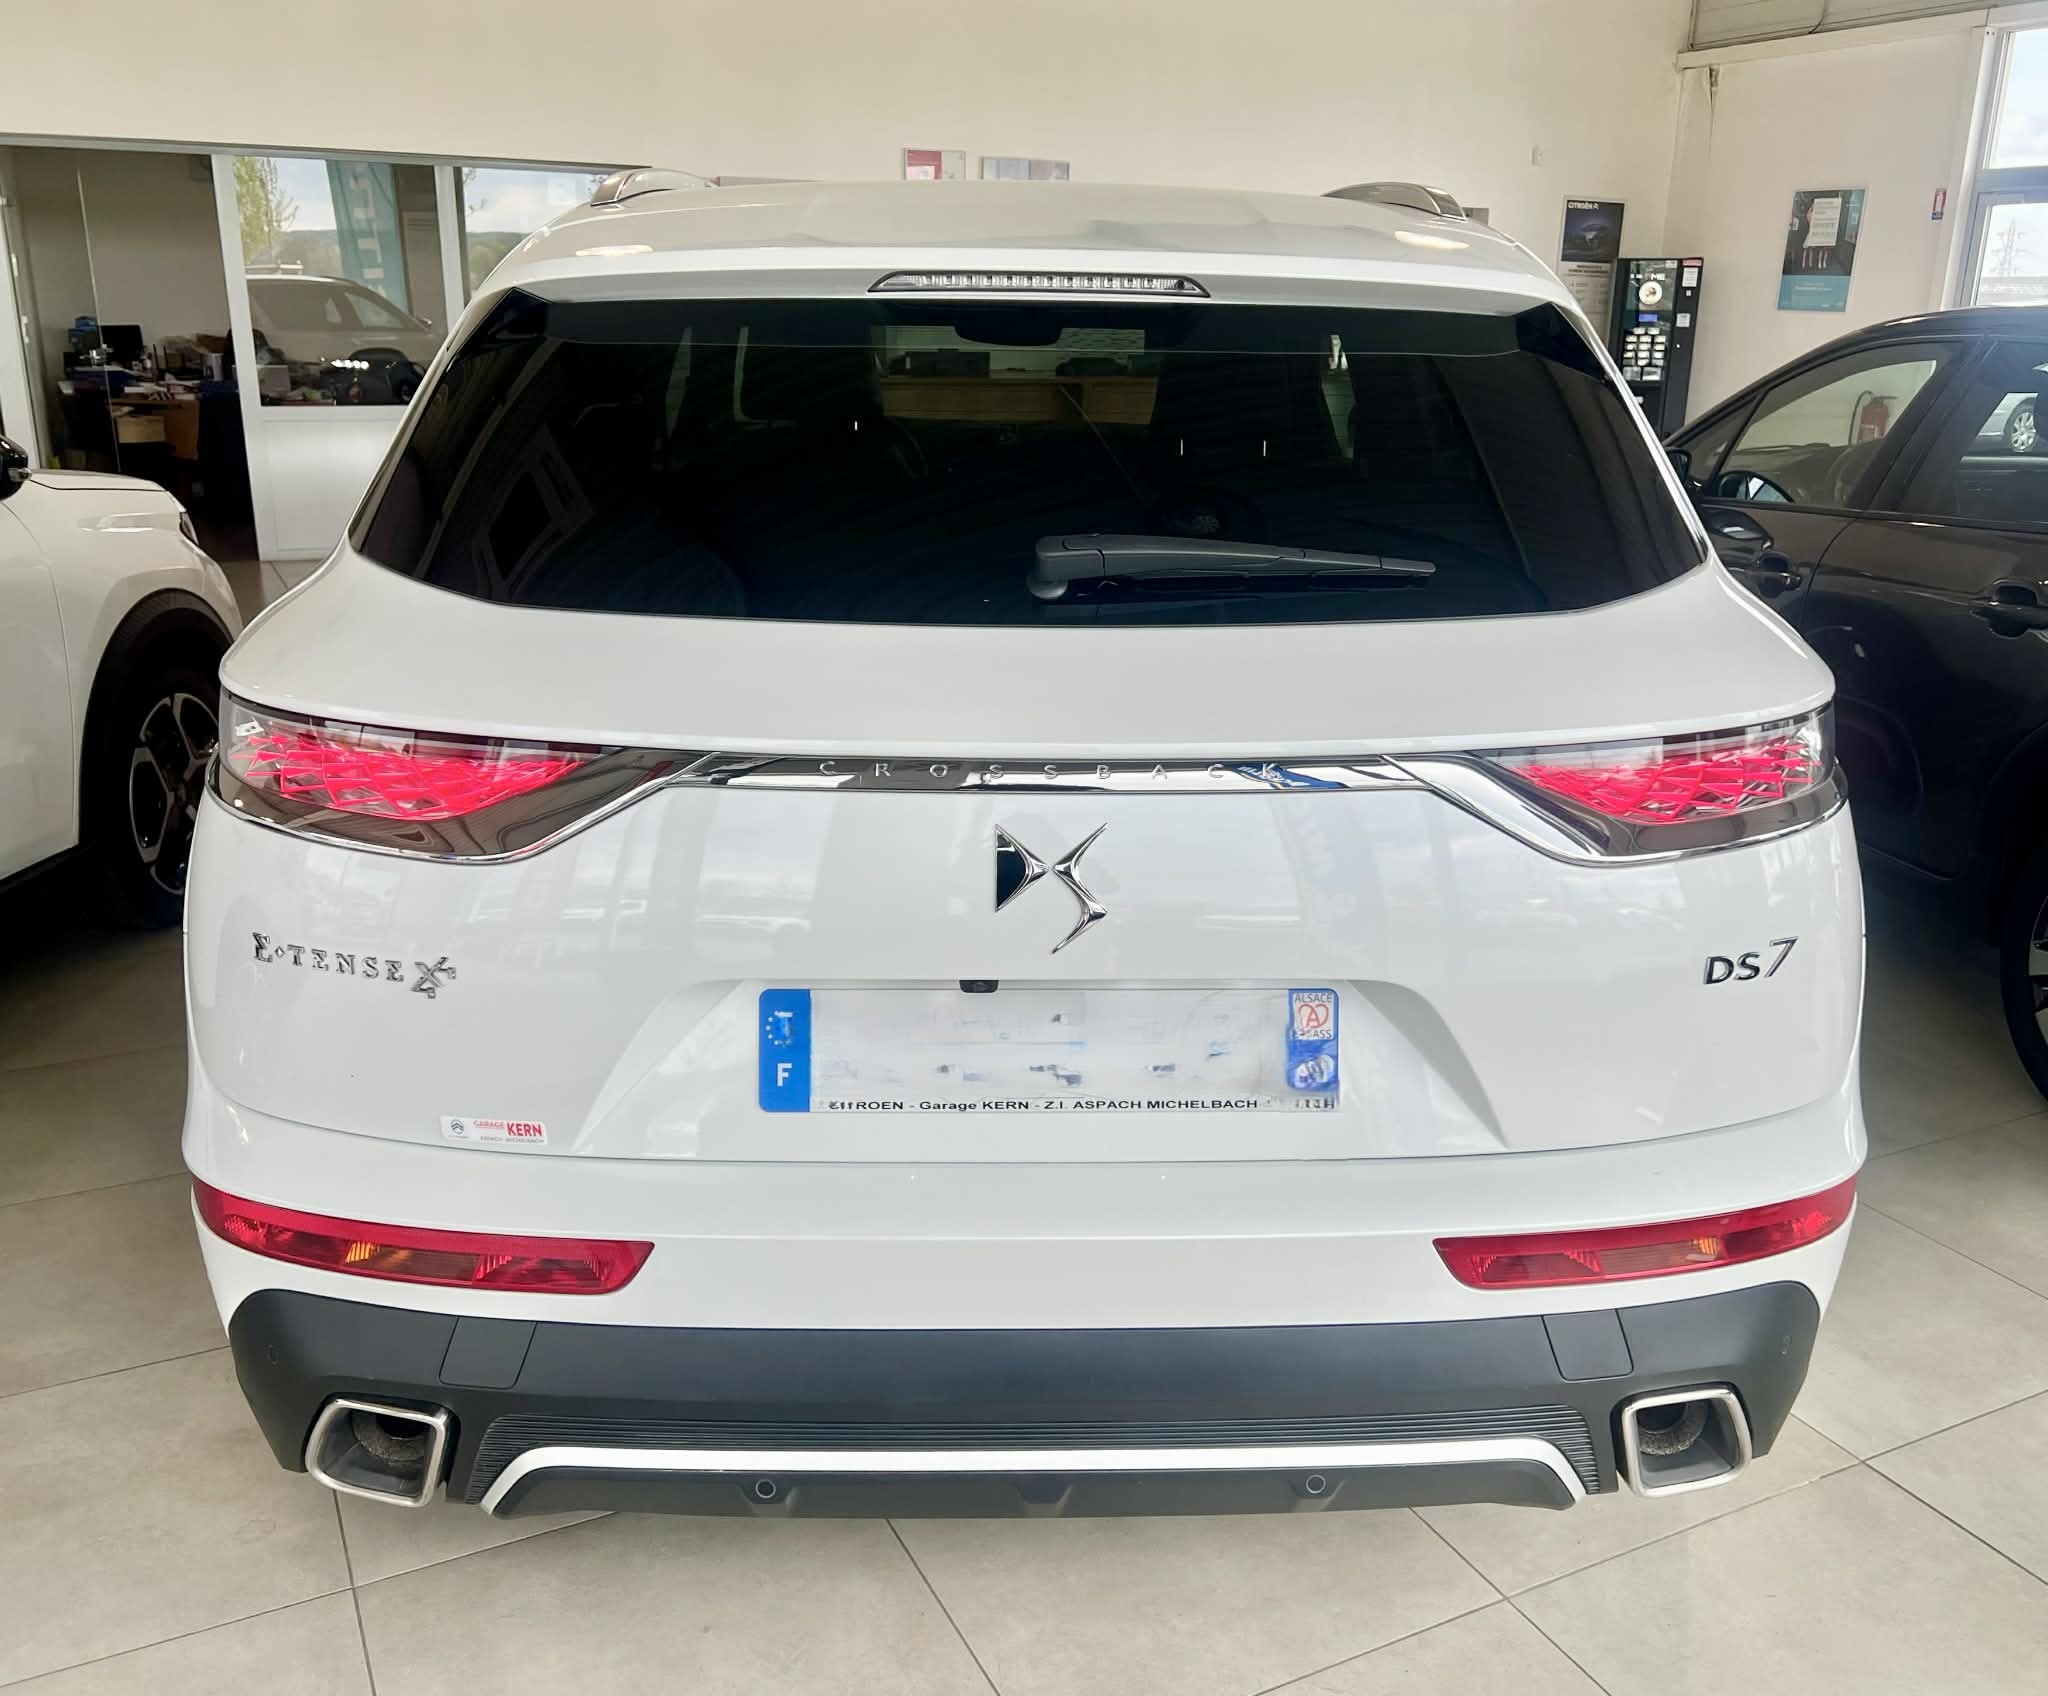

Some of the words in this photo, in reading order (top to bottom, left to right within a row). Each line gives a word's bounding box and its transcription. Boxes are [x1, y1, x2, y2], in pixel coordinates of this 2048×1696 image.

[819, 760, 1278, 779] CROSSBACK
[1295, 993, 1332, 1003] ALSACE
[777, 1063, 792, 1087] F
[920, 1101, 977, 1112] Garage
[983, 1101, 1029, 1109] KERN
[1073, 1101, 1141, 1109] ASPACH
[1147, 1100, 1257, 1109] MICHELBACH
[507, 1122, 543, 1136] KERN
